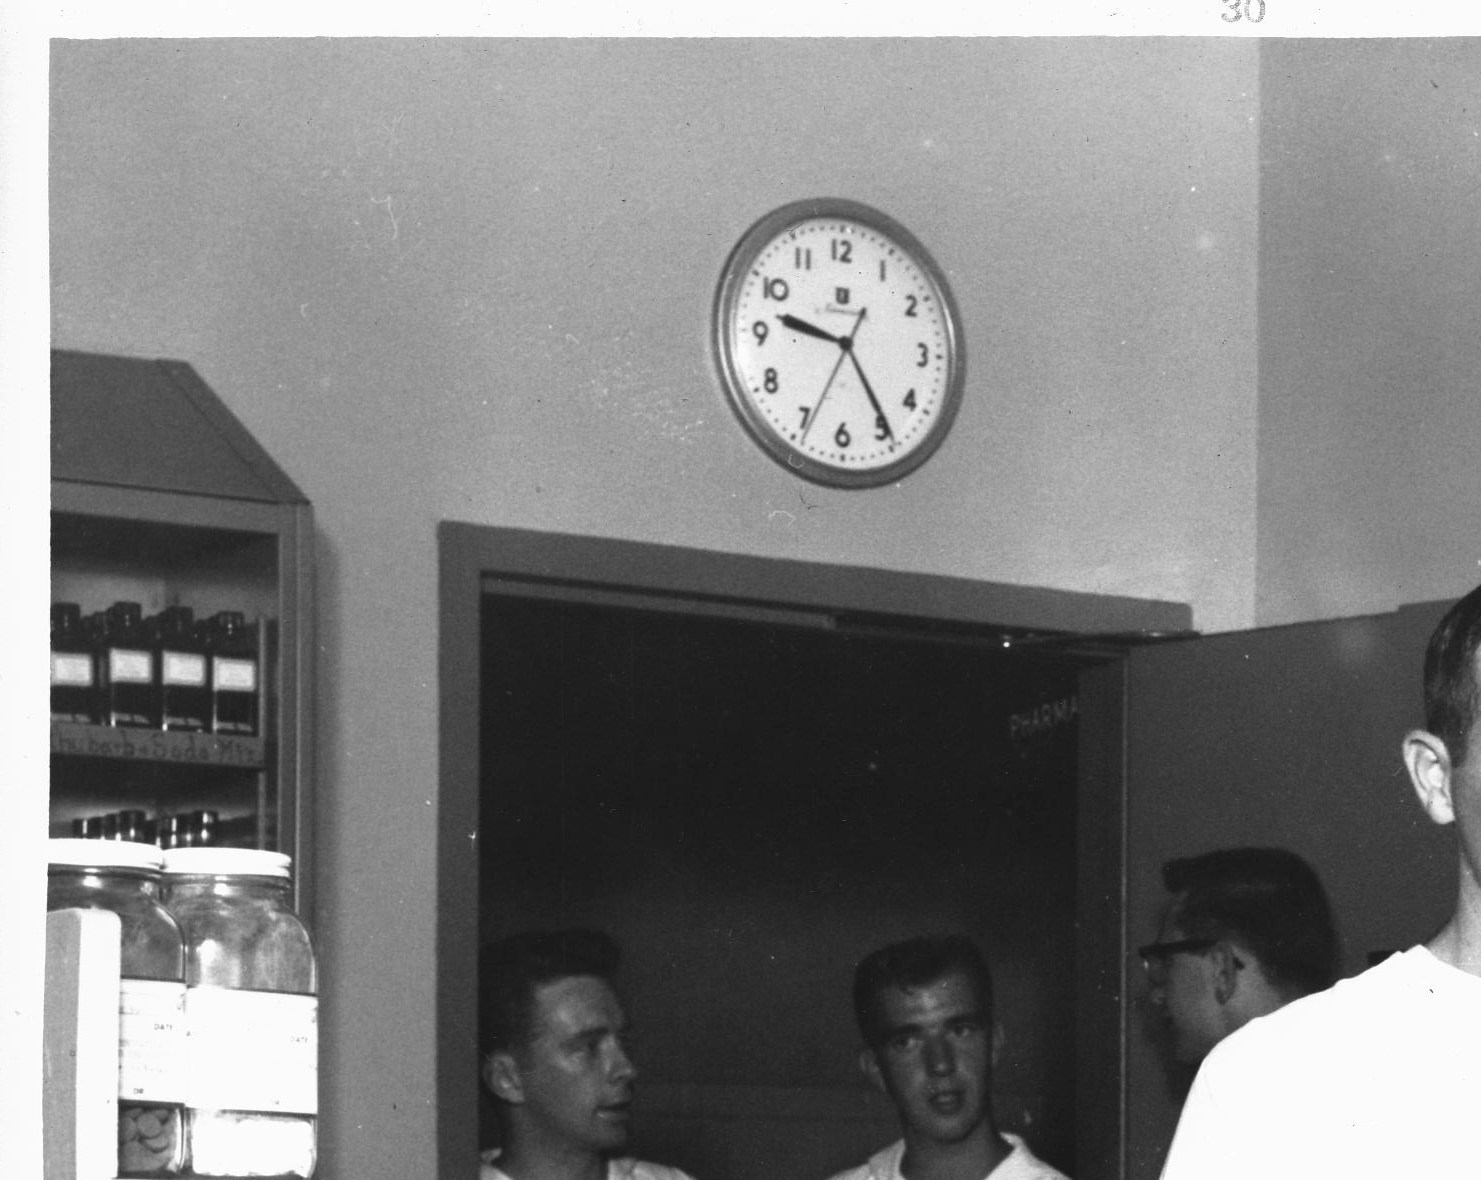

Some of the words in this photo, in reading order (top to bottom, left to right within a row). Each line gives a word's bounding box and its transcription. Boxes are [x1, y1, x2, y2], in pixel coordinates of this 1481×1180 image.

[796, 247, 811, 270] 11
[832, 239, 852, 263] 12
[880, 260, 886, 282] 1
[764, 277, 789, 301] 10
[905, 294, 917, 317] 2
[752, 321, 769, 346] 9
[916, 343, 929, 367] 3
[764, 368, 778, 394] 8
[903, 389, 916, 411] 4
[799, 407, 810, 430] 7
[875, 415, 892, 441] 5
[834, 422, 851, 448] 6
